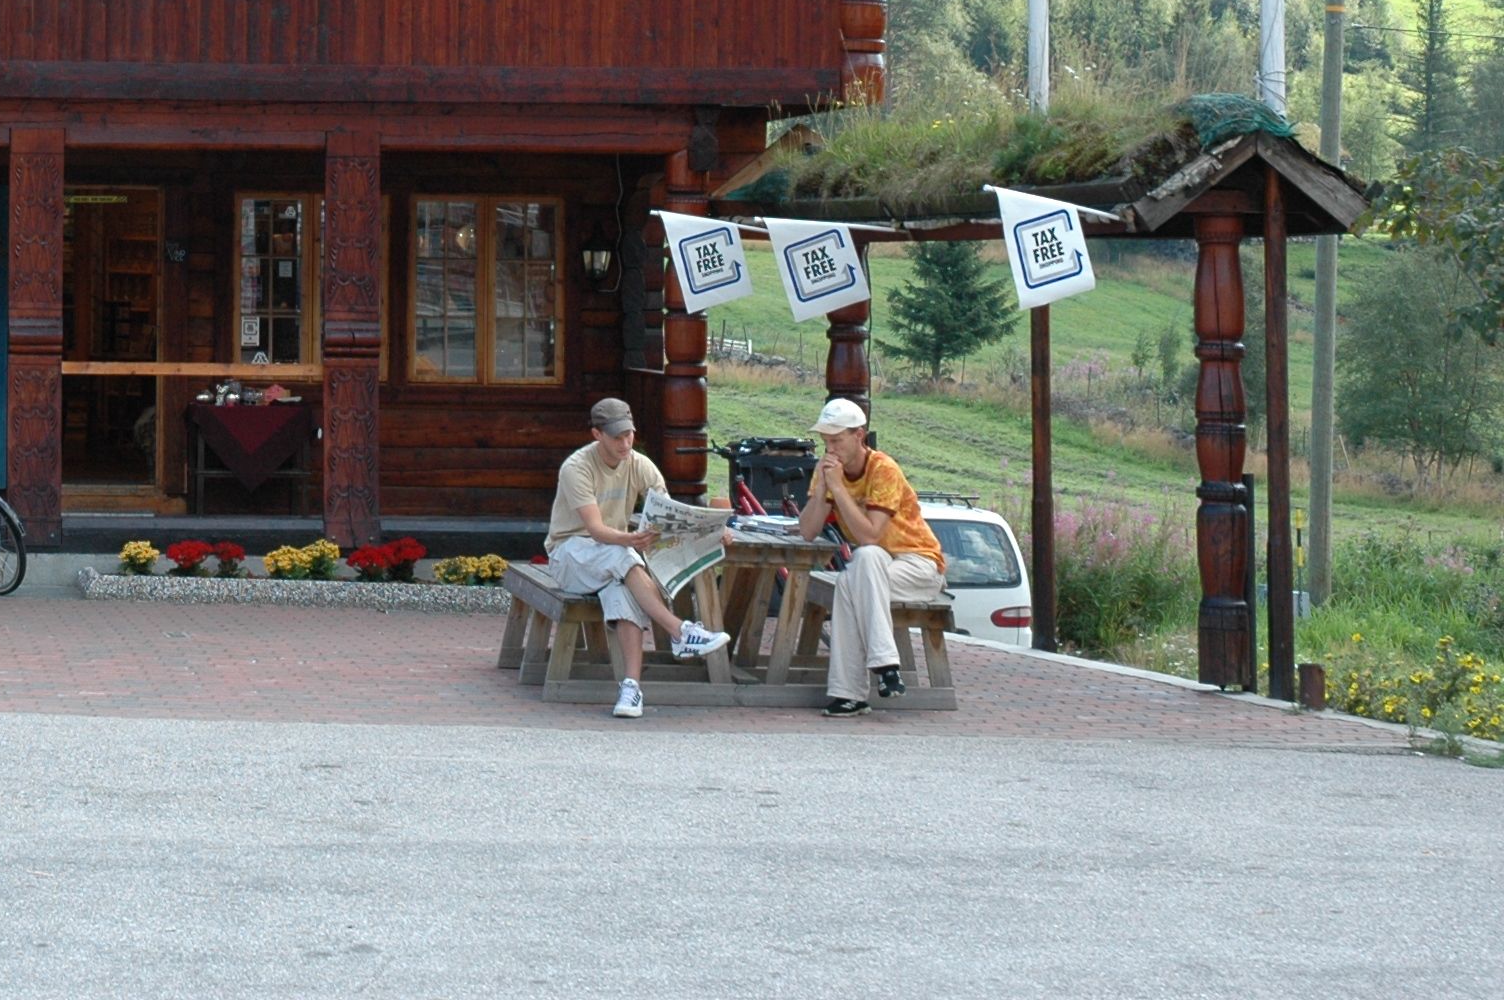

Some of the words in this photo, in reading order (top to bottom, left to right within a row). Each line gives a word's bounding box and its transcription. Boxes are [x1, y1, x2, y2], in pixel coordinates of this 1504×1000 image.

[1031, 226, 1058, 247] TAX
[695, 241, 720, 259] TAX
[802, 245, 831, 265] TAX
[1032, 241, 1065, 264] FREE
[696, 254, 725, 273] FREE
[803, 257, 837, 280] FREE
